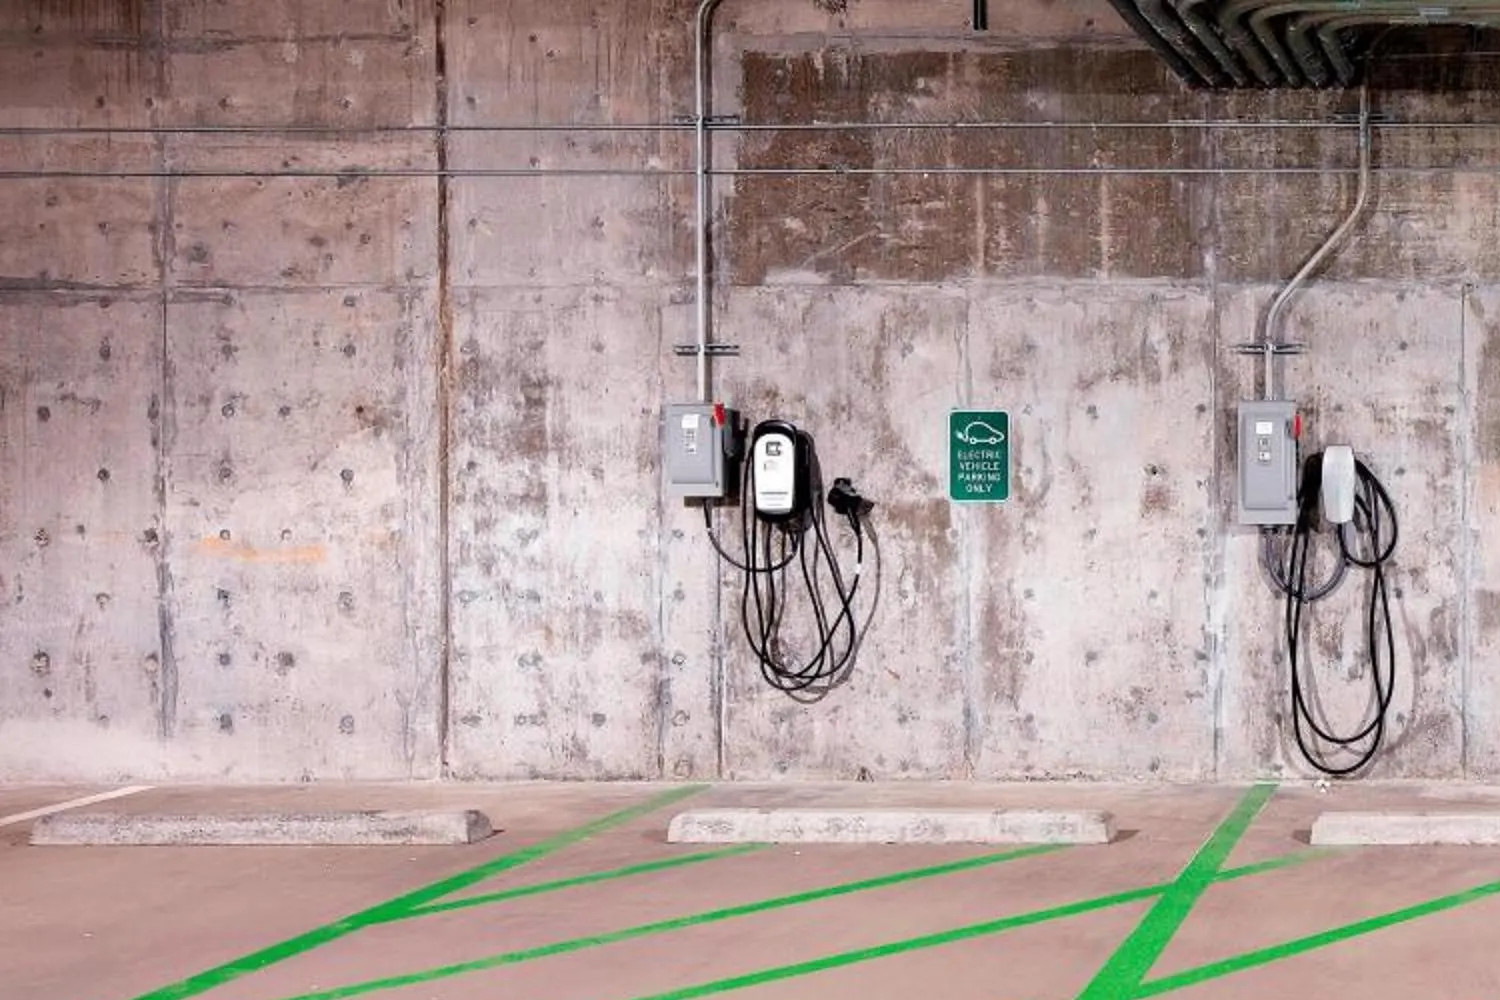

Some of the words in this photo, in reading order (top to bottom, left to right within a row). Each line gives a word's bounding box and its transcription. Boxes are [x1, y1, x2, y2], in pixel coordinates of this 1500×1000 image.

[959, 461, 1001, 471] VEHICLE
[957, 472, 1001, 482] PARKING
[965, 483, 993, 493] ONLY
